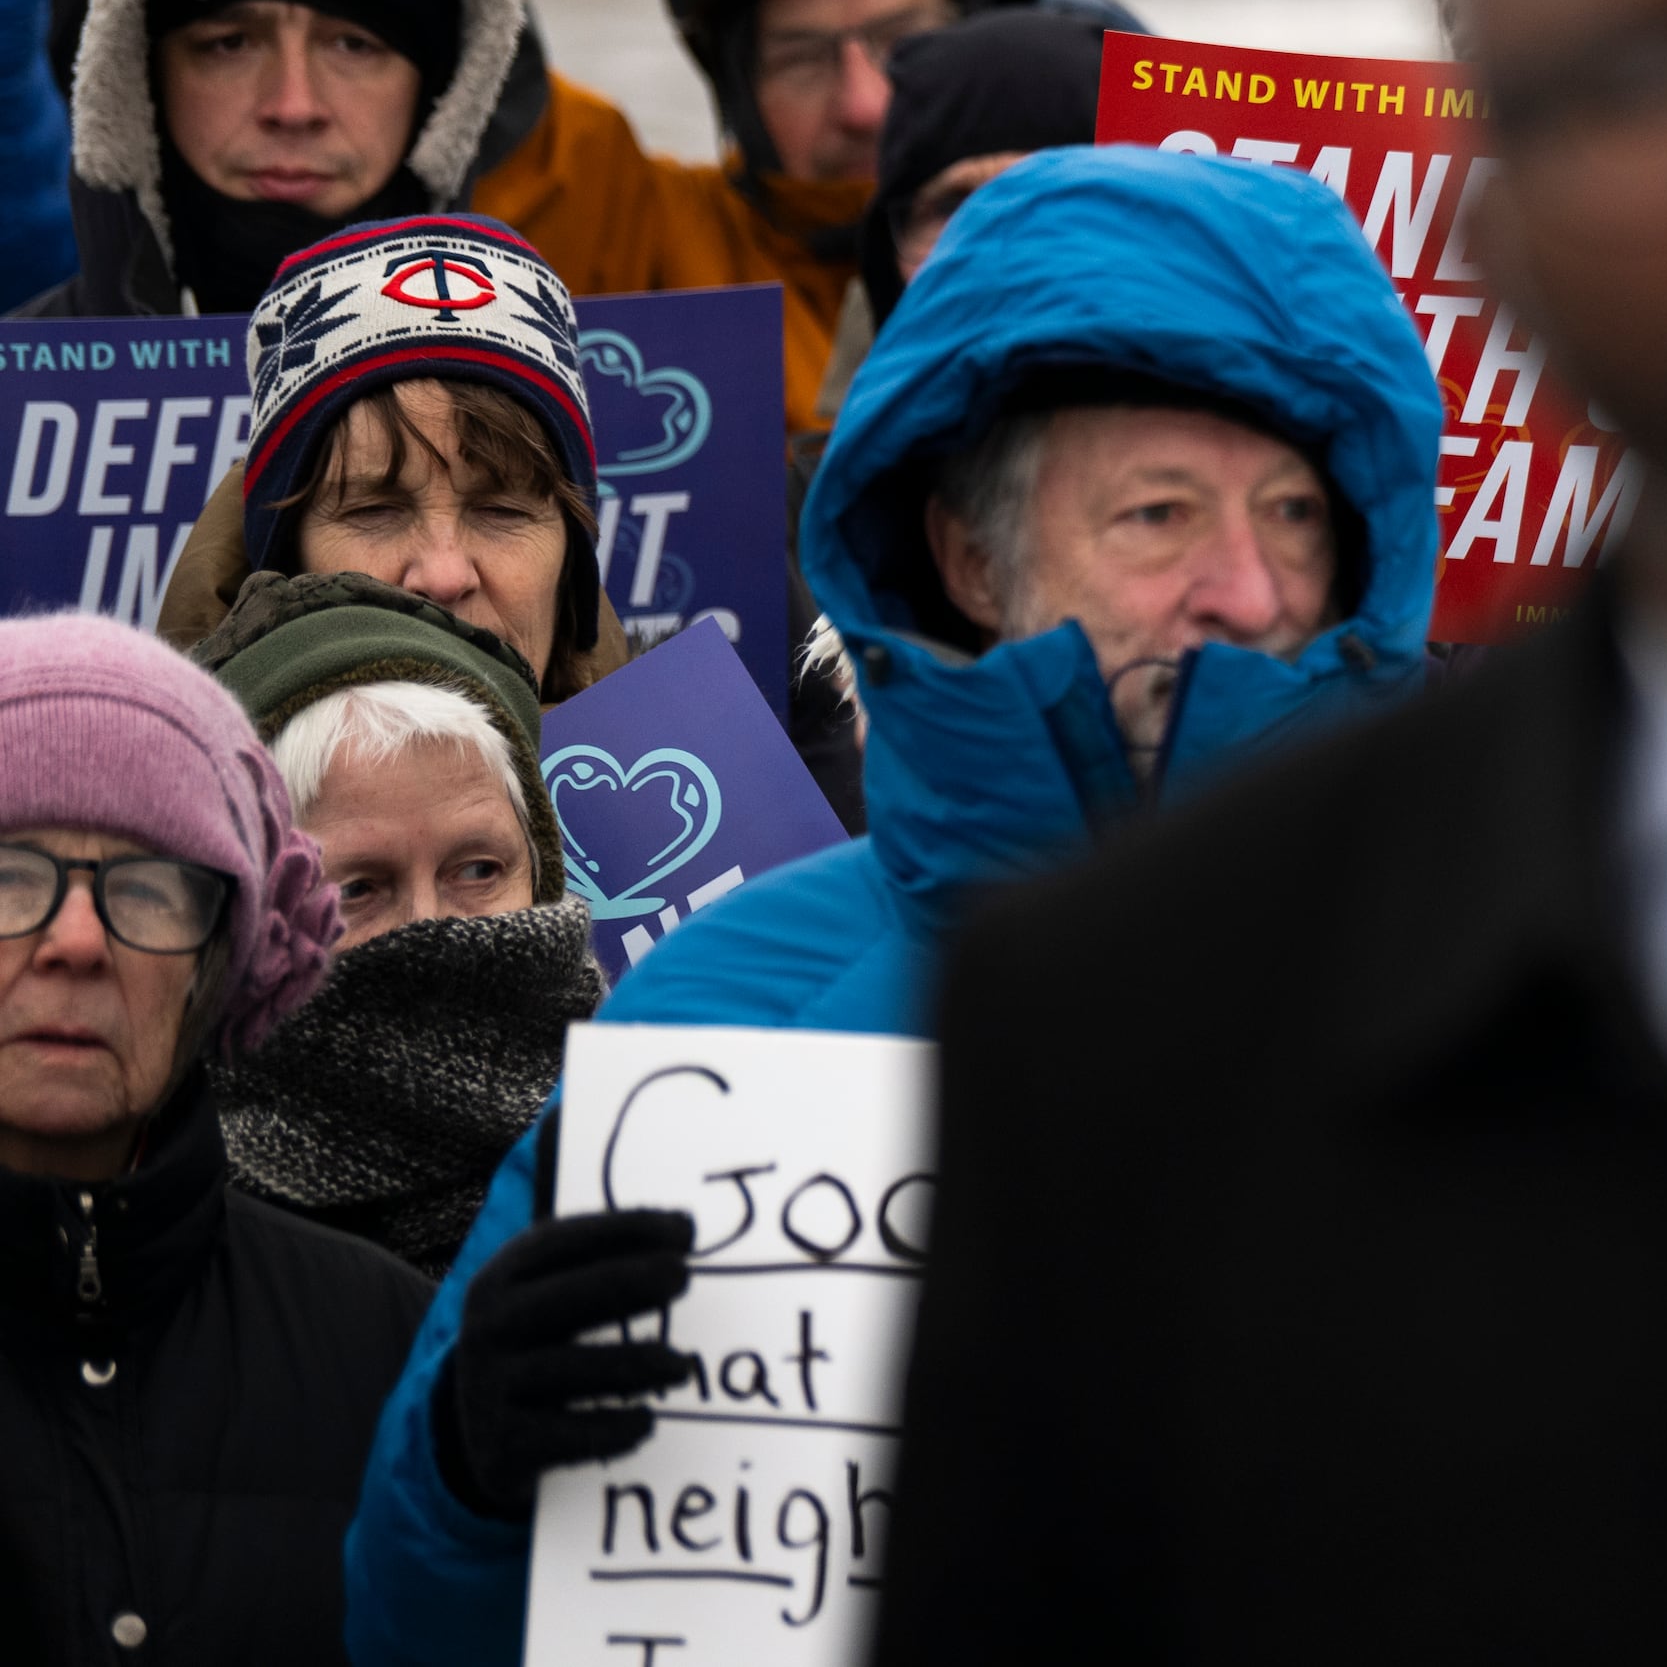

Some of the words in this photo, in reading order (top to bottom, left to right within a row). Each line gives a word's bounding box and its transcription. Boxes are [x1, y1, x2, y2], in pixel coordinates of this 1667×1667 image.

[1131, 60, 1276, 105] STAND
[1293, 78, 1405, 116] WITH
[129, 338, 231, 369] WITH
[600, 1460, 894, 1627] neigh
